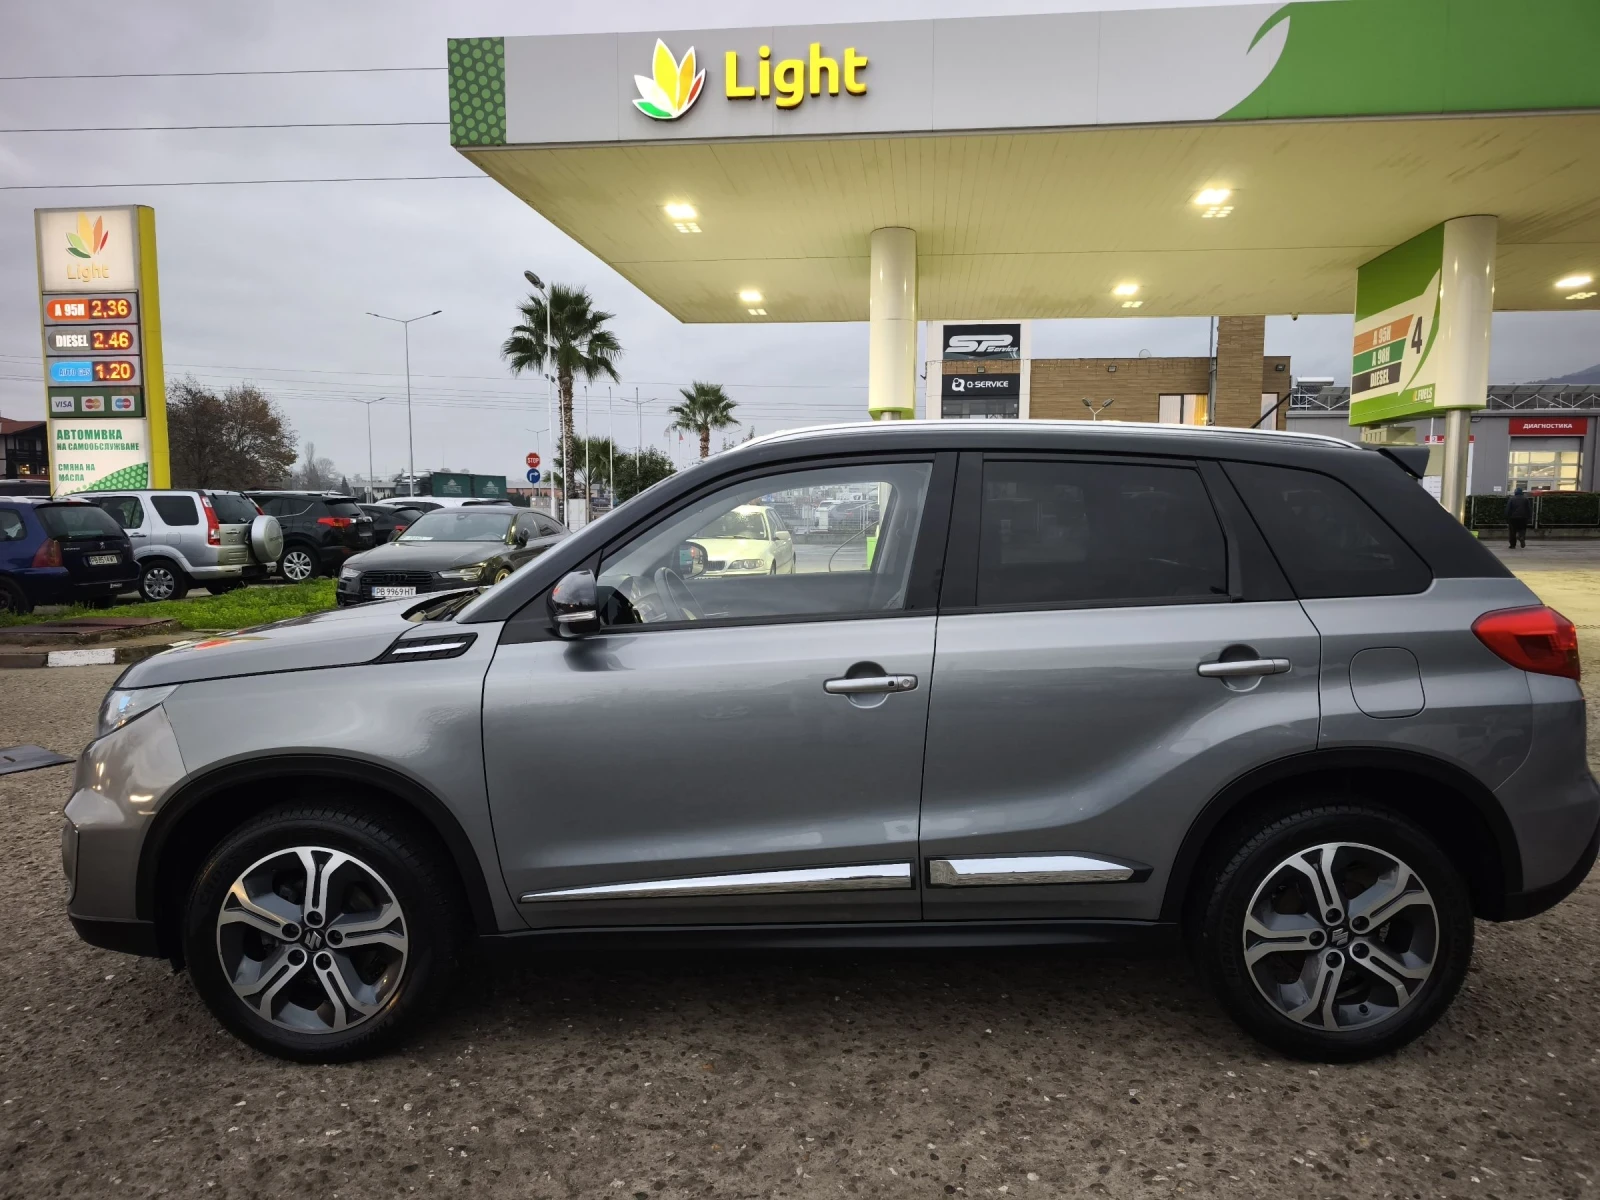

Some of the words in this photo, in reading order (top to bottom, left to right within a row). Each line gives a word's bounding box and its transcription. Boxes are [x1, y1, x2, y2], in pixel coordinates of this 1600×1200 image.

[725, 42, 868, 110] Light
[66, 263, 109, 282] Light
[56, 334, 88, 347] DIESEL
[94, 332, 129, 348] 2.46
[1411, 316, 1422, 354] 4
[945, 334, 1013, 353] SP
[95, 363, 130, 379] 1.20
[1370, 368, 1389, 388] DIESEL
[55, 400, 72, 408] VISA
[57, 429, 122, 440] АВТОМИВКА
[68, 442, 139, 450] САМООБСЛУЖВАНЕ
[58, 463, 84, 471] СМЯНА
[86, 463, 95, 471] НА
[376, 587, 385, 595] PB
[387, 587, 403, 595] 9969
[405, 587, 414, 595] HT
